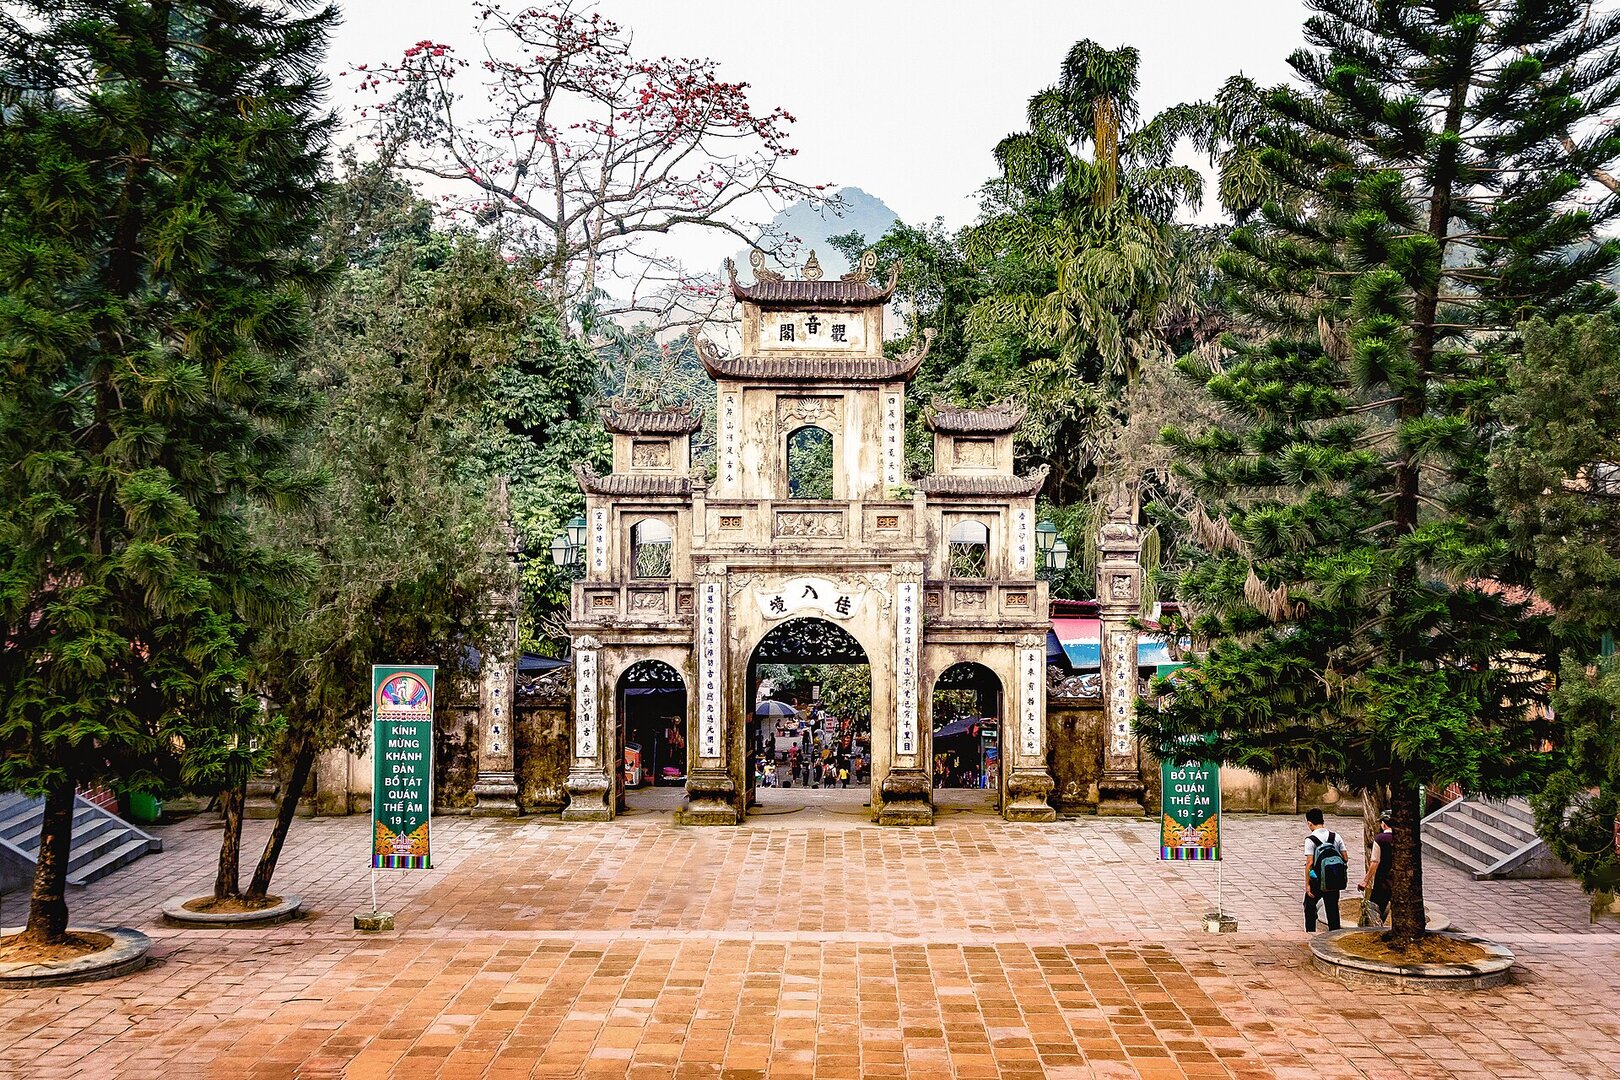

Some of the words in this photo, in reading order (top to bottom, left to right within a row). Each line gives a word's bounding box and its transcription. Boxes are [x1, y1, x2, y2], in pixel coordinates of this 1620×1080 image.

[391, 725, 417, 735] KÍNH
[388, 737, 420, 748] MỪNG
[385, 750, 422, 761] KHÁNH
[392, 762, 415, 774] ĐẢN
[1188, 769, 1209, 780] TÁT
[402, 775, 423, 787] TÁT
[1174, 782, 1205, 793] QUÁN
[388, 788, 418, 799] QUÁN
[1169, 793, 1191, 805] THẾ
[1193, 794, 1210, 805] ÂM
[383, 800, 404, 813] THẾ
[406, 801, 423, 813] ÂM
